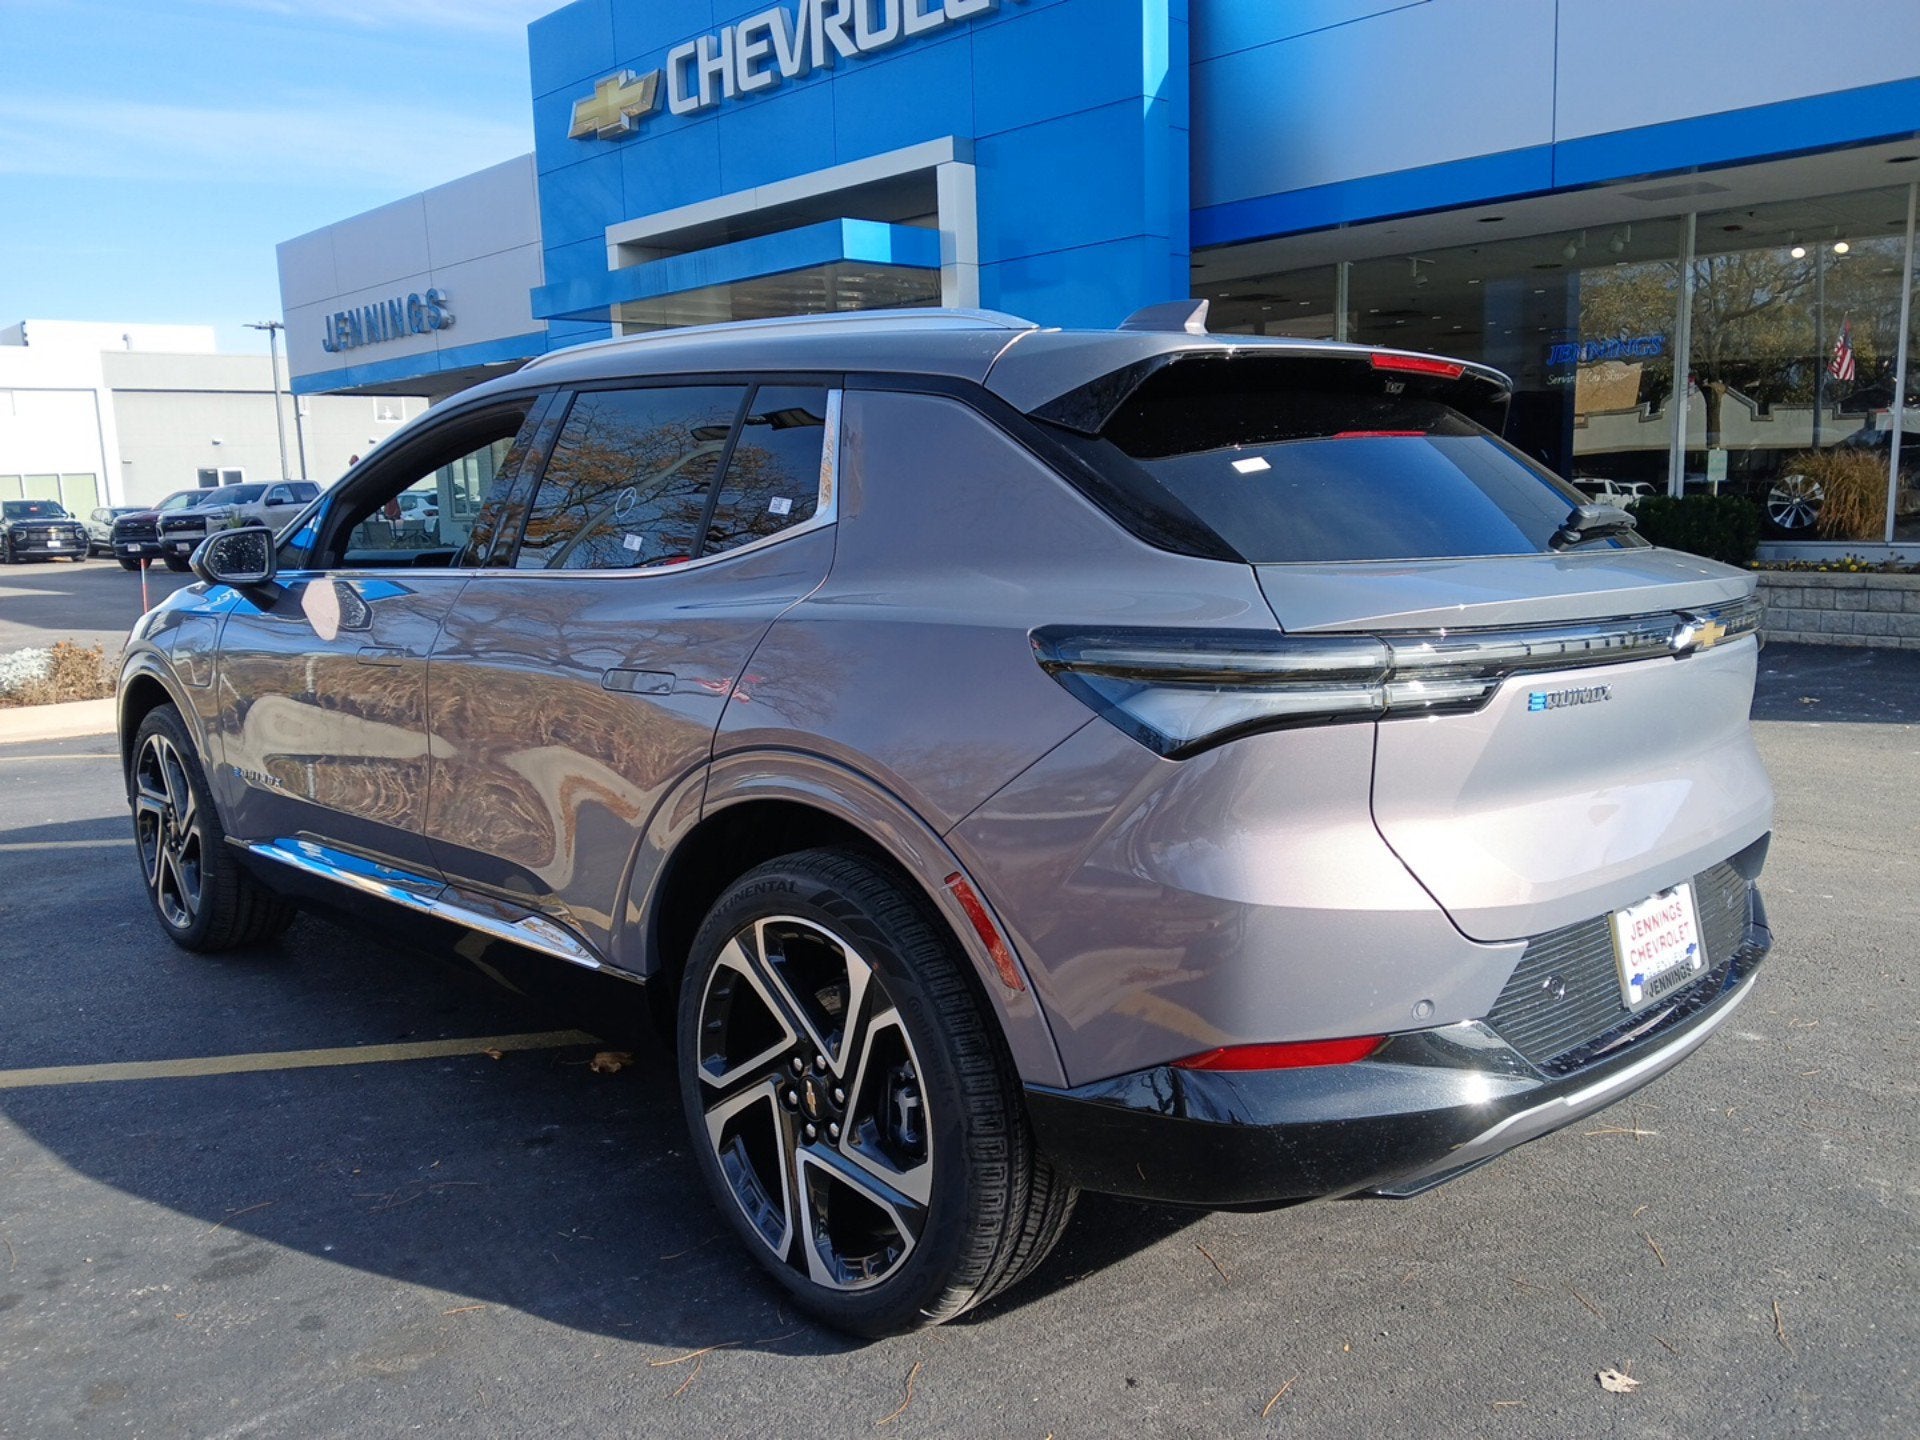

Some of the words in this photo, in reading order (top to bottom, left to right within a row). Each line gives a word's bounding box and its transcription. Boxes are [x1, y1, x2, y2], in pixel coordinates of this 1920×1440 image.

[667, 0, 1001, 116] CHEVRO
[322, 287, 452, 353] JENNINGS
[1546, 335, 1665, 366] JENNINGS
[1630, 900, 1683, 942] JENNINGS
[1630, 921, 1690, 968] CHEVROLET
[1648, 959, 1695, 998] JENNINGS
